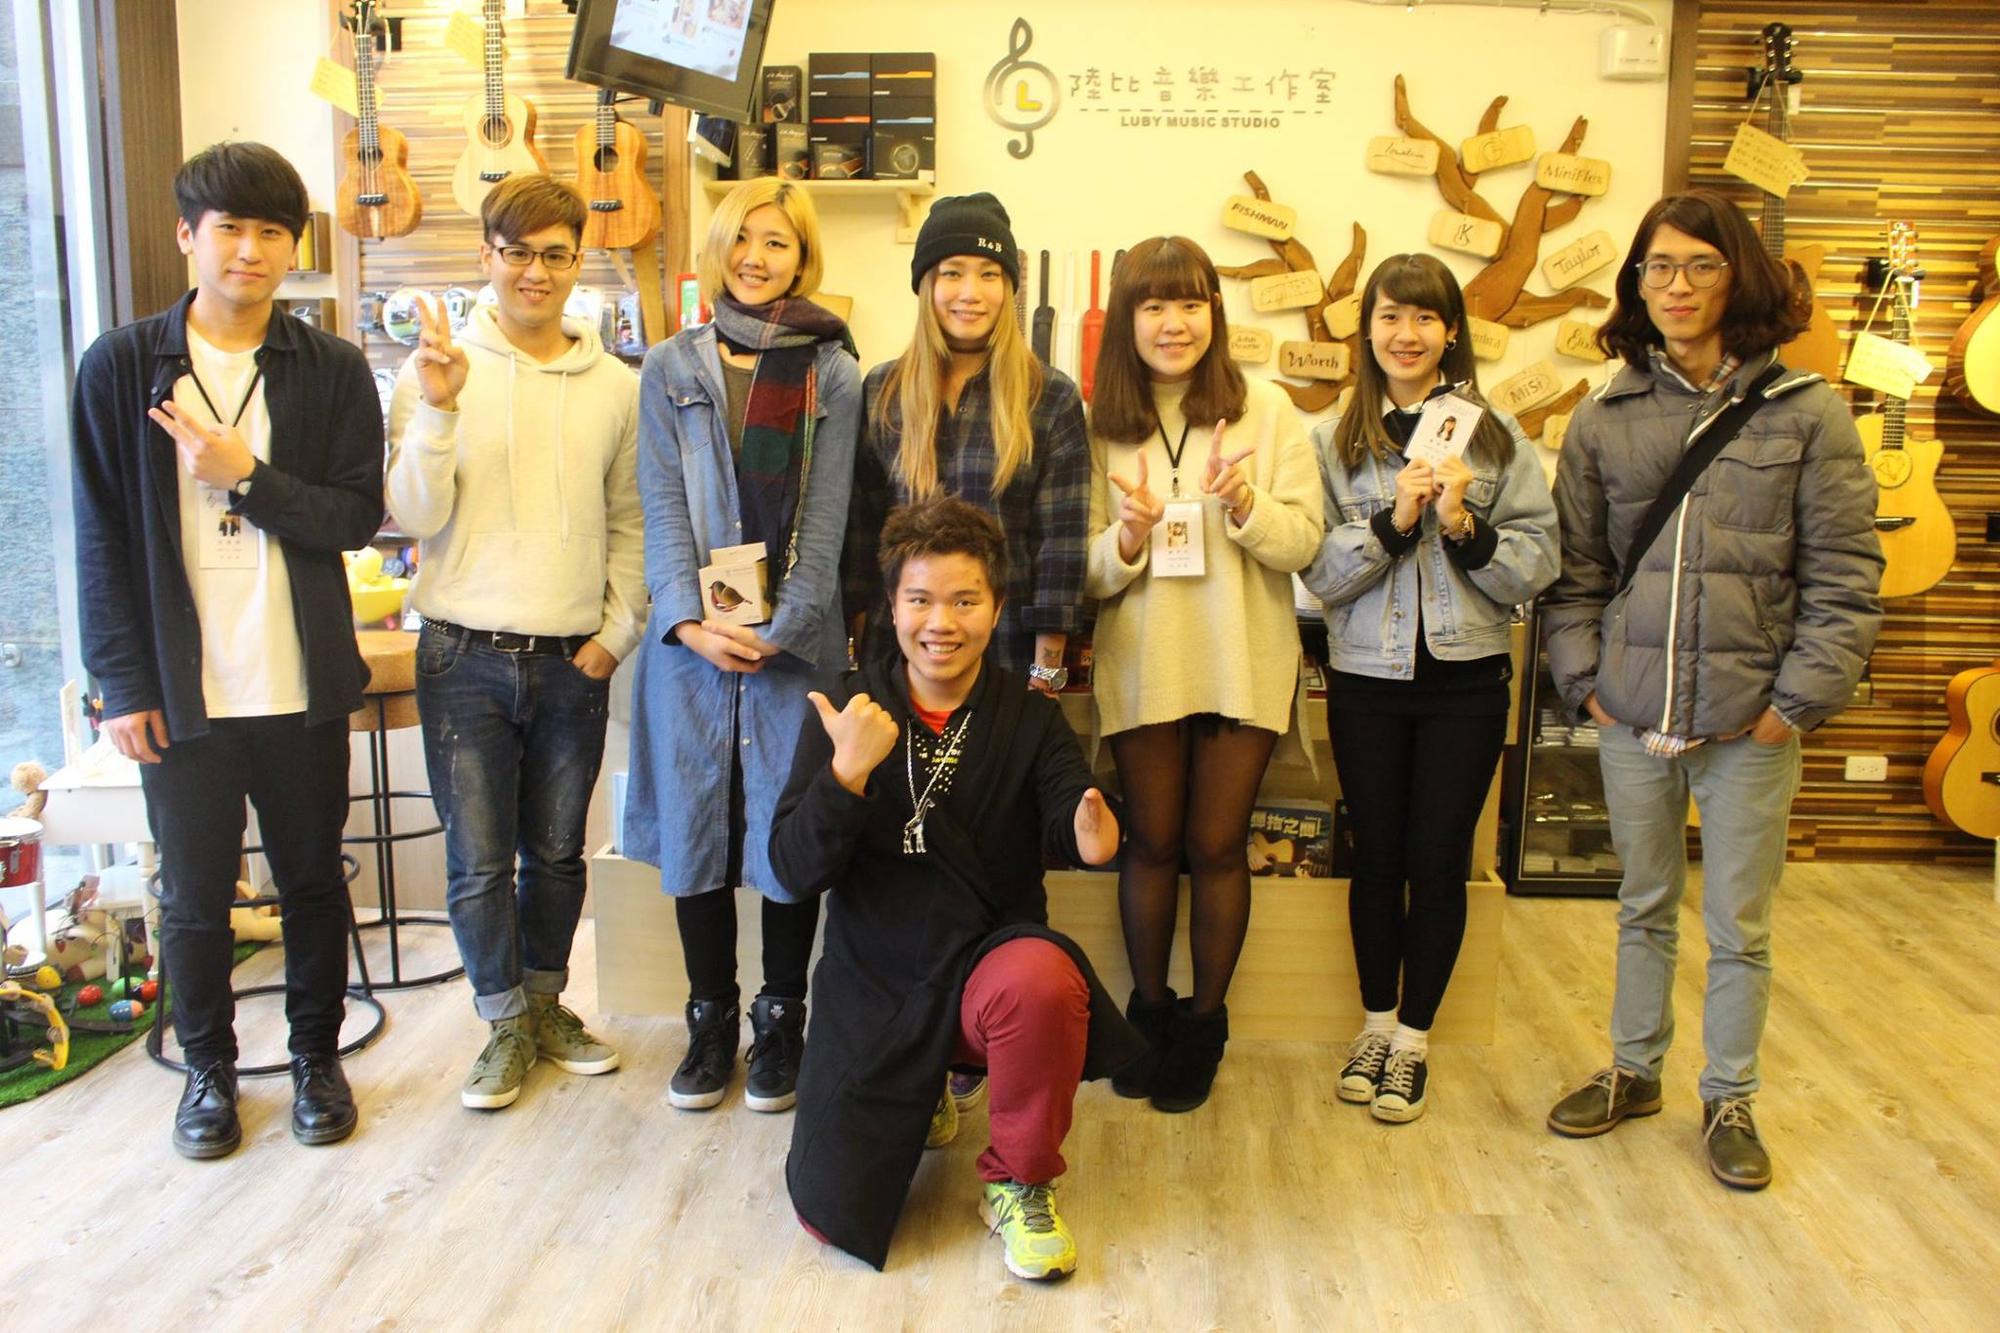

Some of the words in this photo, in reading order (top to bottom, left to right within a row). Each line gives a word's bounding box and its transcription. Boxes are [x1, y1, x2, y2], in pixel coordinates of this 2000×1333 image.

[1068, 66, 1337, 105] 陸比音樂工作室
[1120, 115, 1162, 128] LUBY
[1166, 115, 1217, 129] MUSIC
[1220, 116, 1281, 130] STUDIO
[1231, 202, 1289, 230] FISHMAN
[1552, 244, 1600, 275] Taylor
[1288, 351, 1339, 369] Worth
